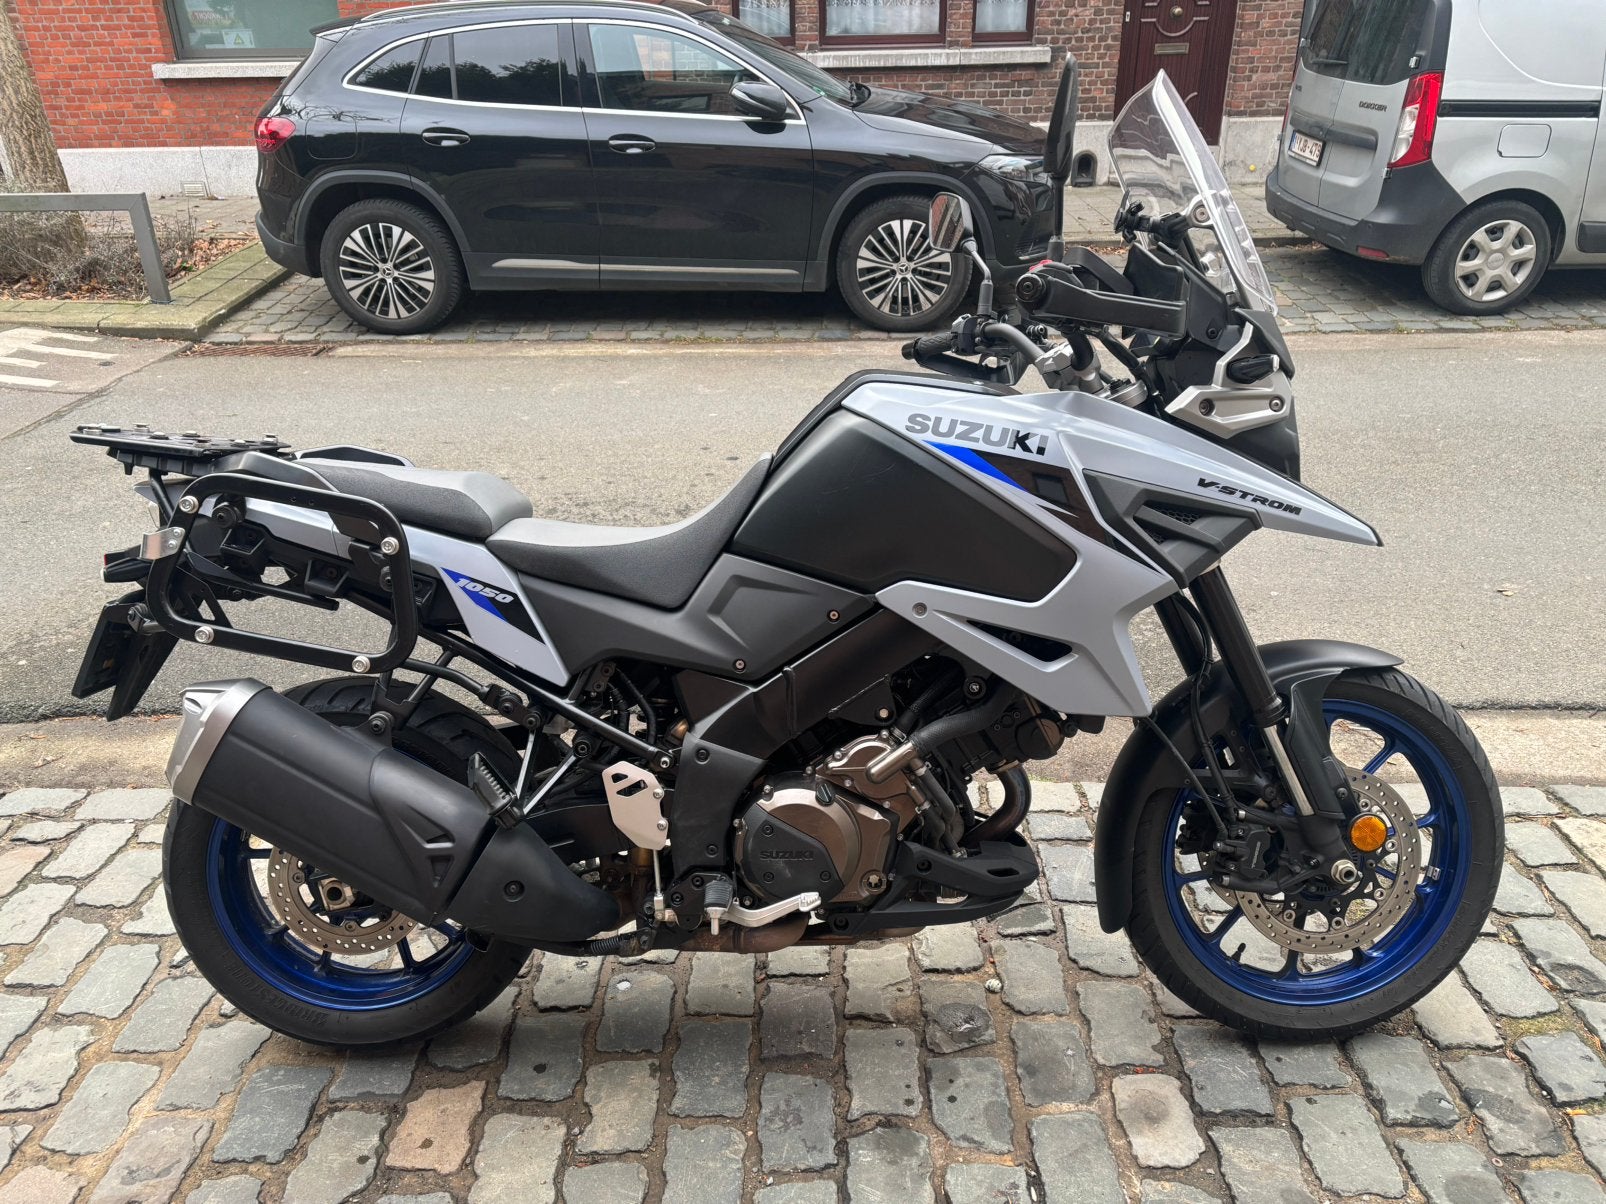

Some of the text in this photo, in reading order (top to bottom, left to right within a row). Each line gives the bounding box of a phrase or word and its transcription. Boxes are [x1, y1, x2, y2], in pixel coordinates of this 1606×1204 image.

[1359, 101, 1388, 112] DOKKER
[904, 413, 1049, 456] SUZUKI
[1197, 477, 1302, 516] V-STROM
[456, 578, 514, 603] 1050
[759, 850, 815, 860] SUZUKI
